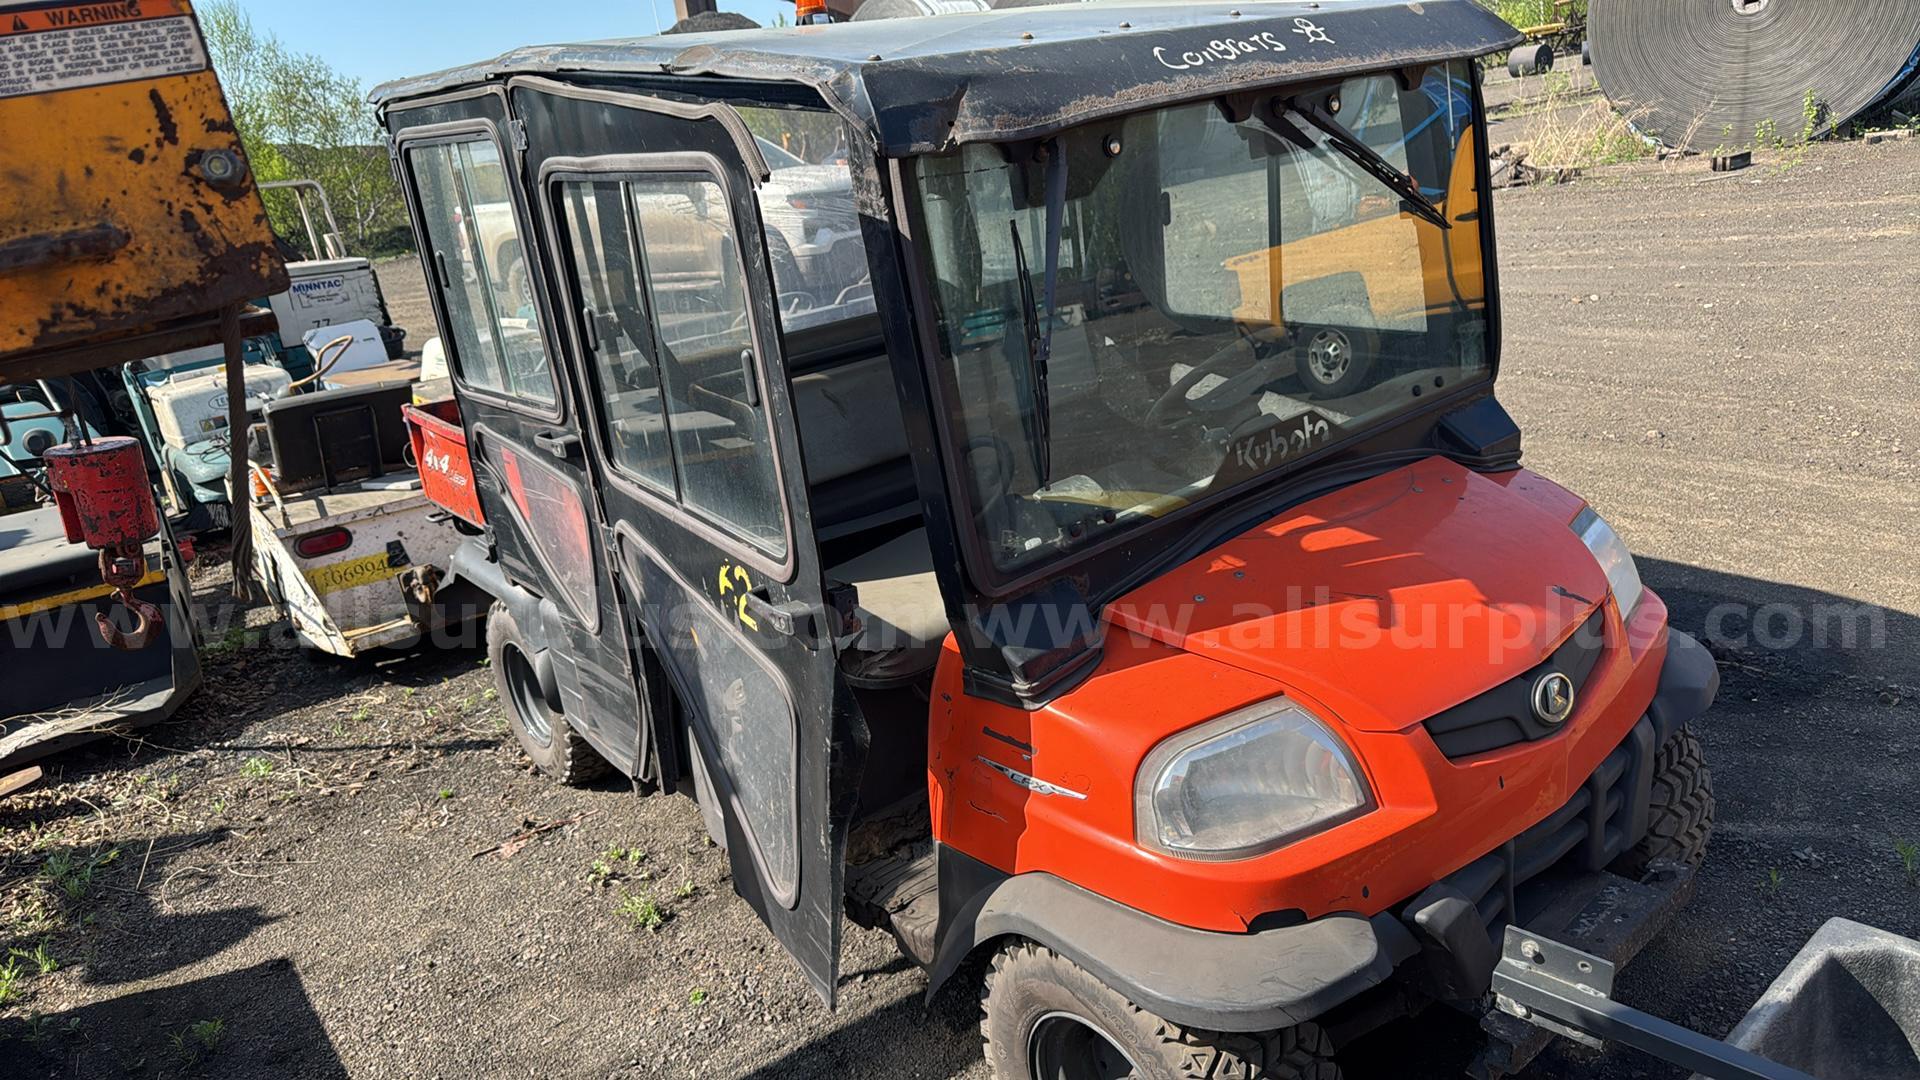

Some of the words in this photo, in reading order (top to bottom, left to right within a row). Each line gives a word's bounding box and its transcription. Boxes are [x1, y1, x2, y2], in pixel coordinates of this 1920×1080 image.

[45, 2, 142, 26] WARNING
[292, 279, 342, 293] MINNTAC
[1235, 415, 1329, 471] Kubota
